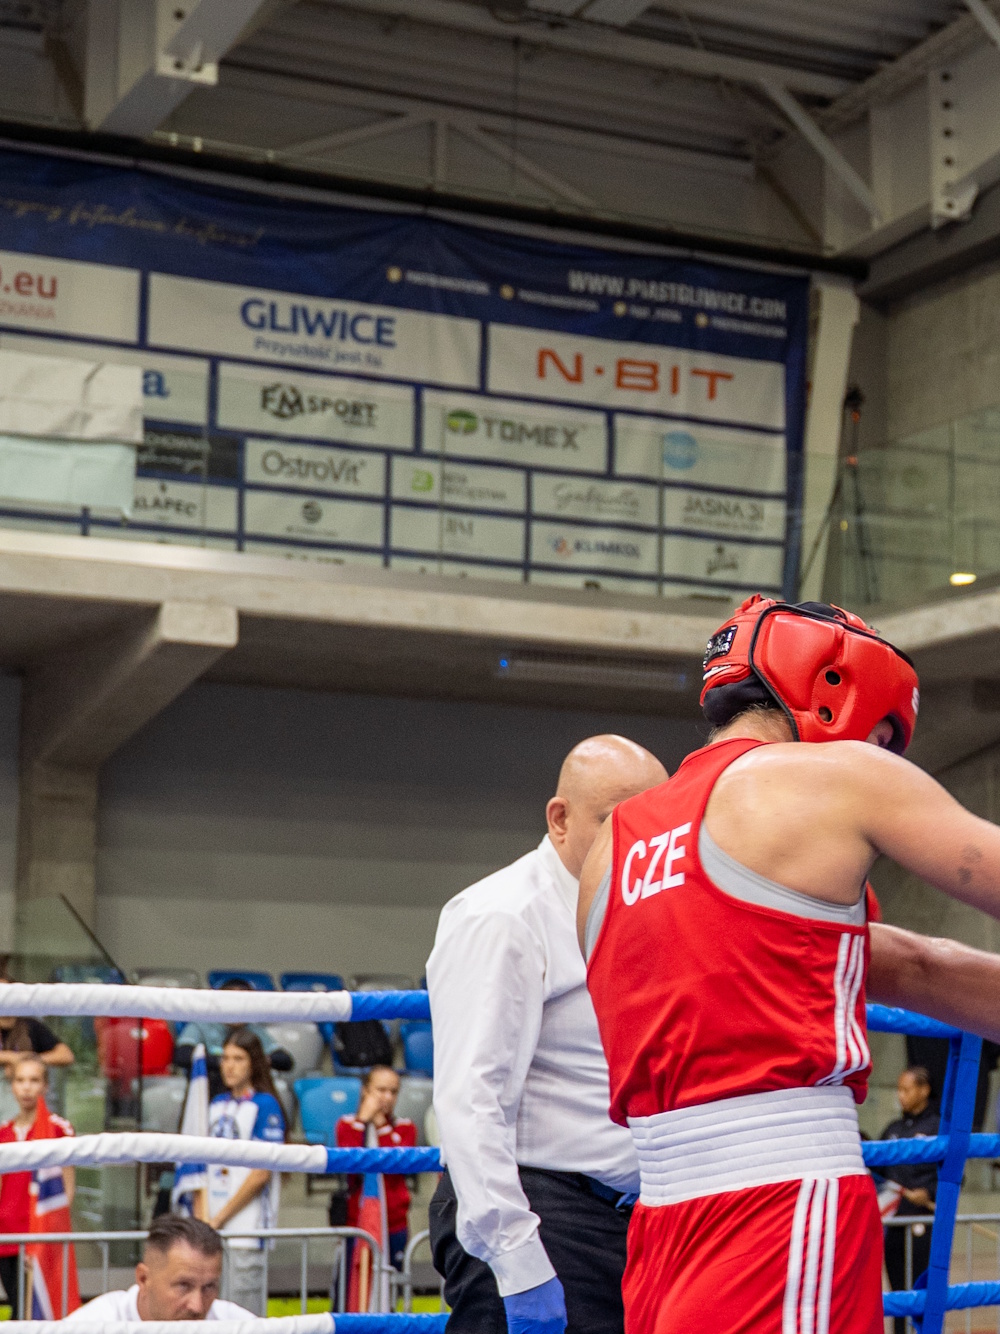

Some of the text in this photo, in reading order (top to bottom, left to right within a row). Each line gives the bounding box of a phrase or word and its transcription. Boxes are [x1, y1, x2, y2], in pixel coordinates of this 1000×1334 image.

[0, 269, 58, 299] .eu
[240, 298, 397, 348] GLIWICE
[483, 416, 581, 451] TOMEX
[620, 821, 693, 907] CZE
